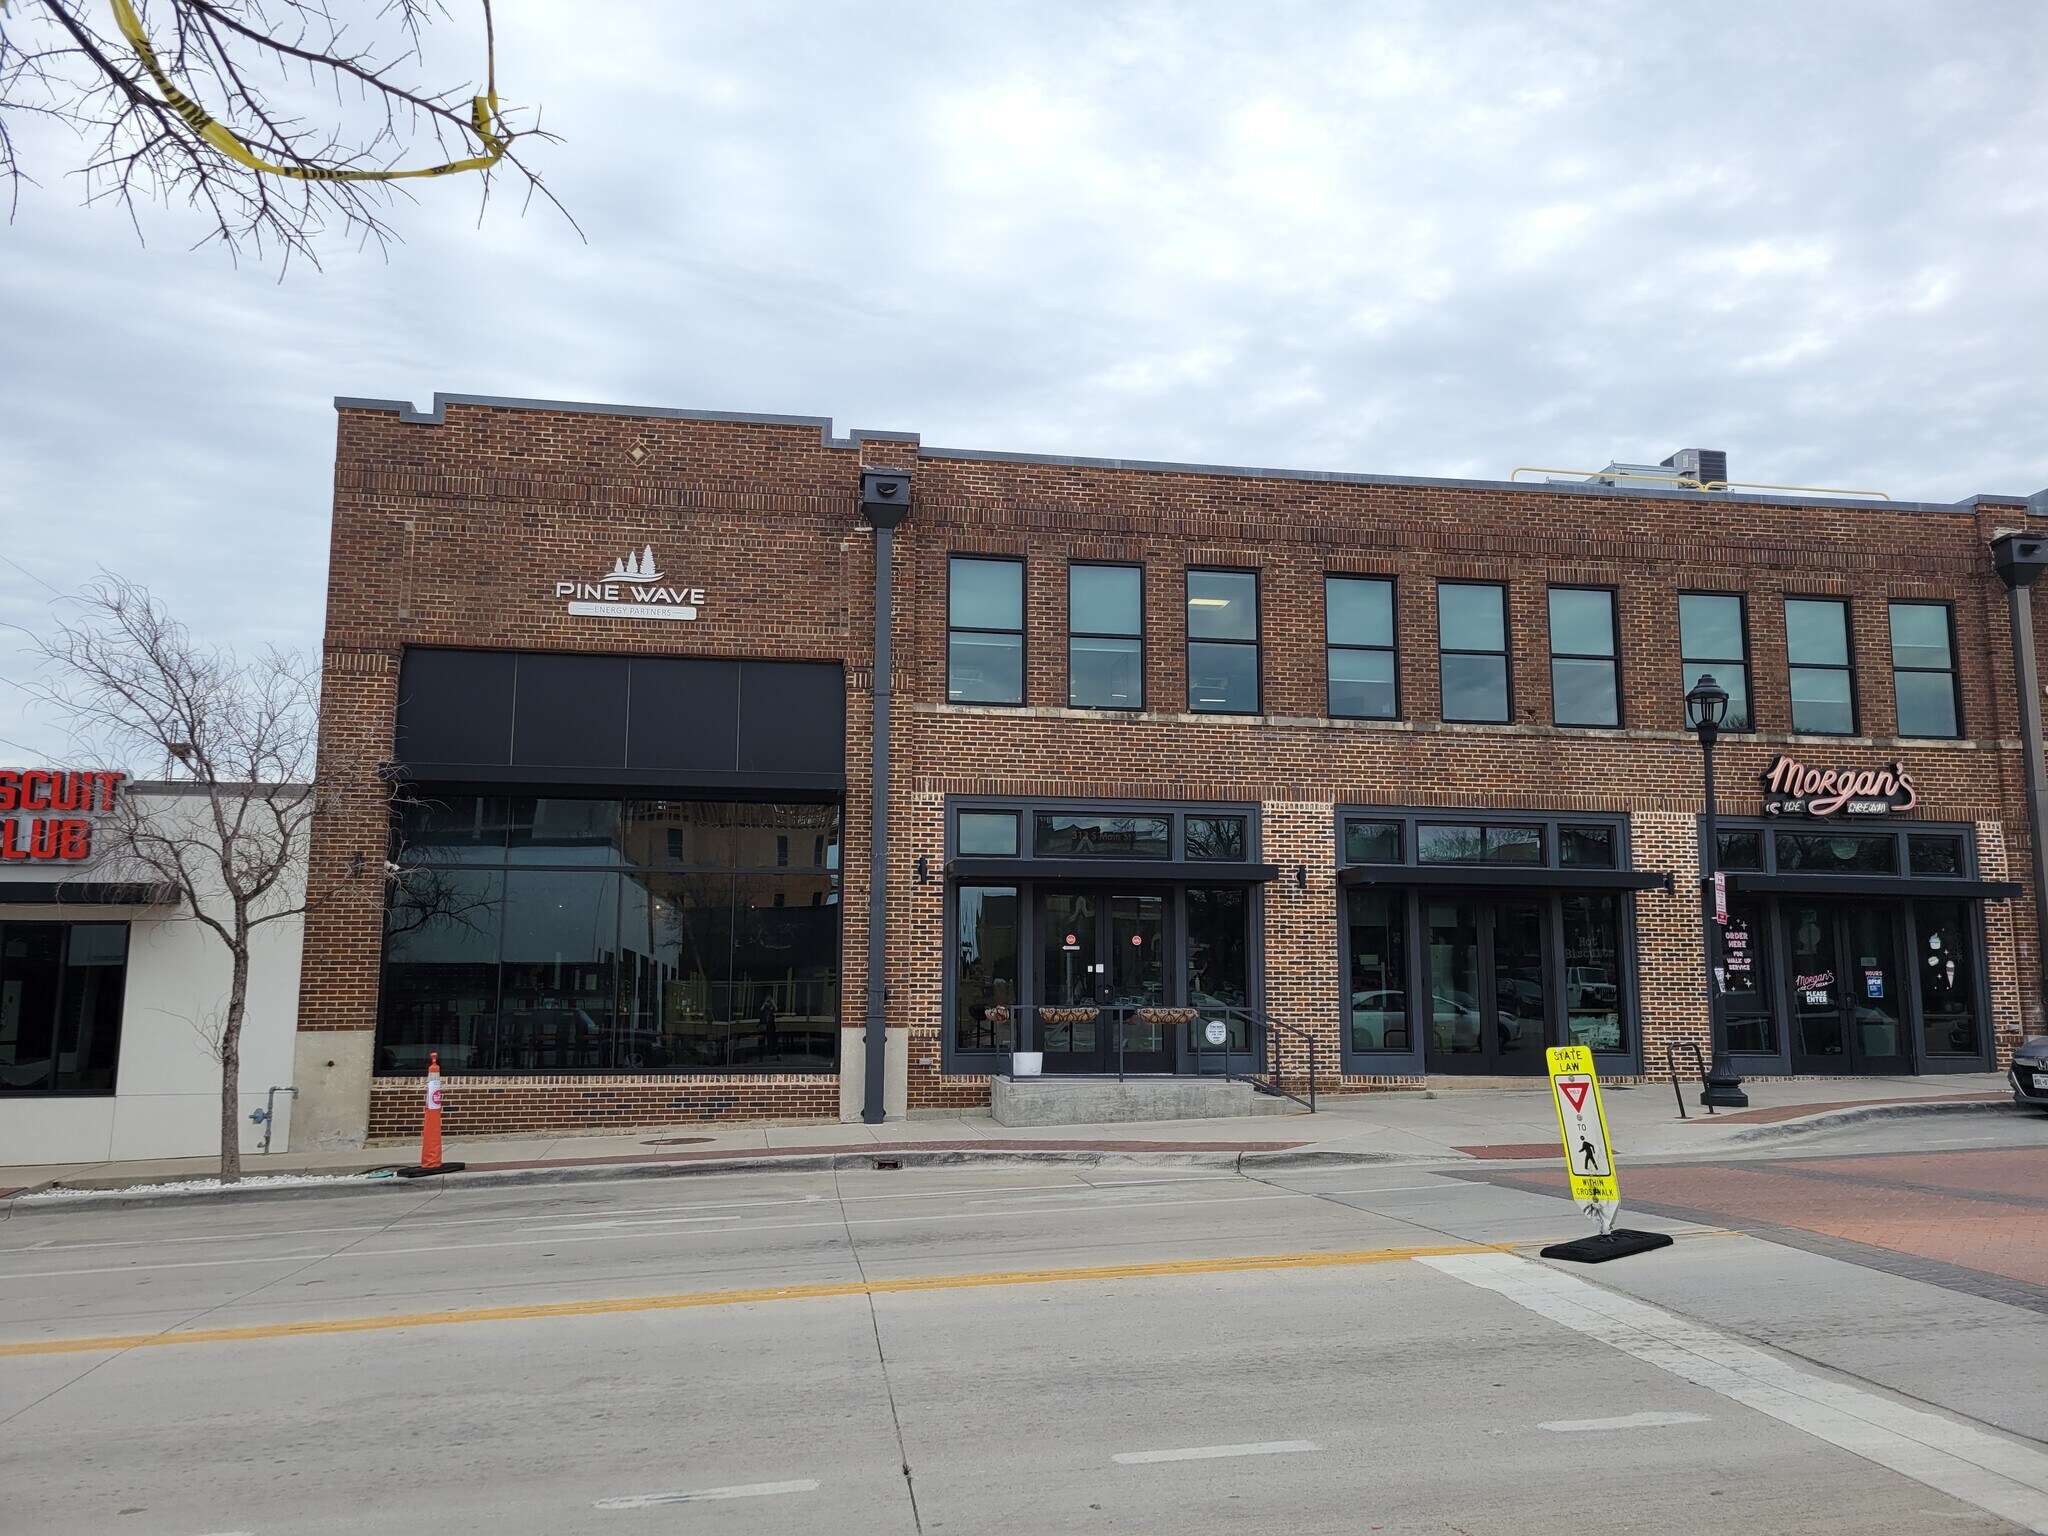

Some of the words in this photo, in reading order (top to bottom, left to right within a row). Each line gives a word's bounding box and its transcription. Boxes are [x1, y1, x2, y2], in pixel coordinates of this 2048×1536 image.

[556, 582, 620, 600] PINE
[630, 586, 705, 605] WAVE
[594, 606, 627, 614] ENERGY
[630, 607, 672, 616] PARTNERS
[1767, 755, 1917, 815] Morgan's
[0, 770, 124, 811] SCUIT
[1091, 831, 1097, 840] S
[1099, 832, 1121, 841] Main
[1123, 832, 1131, 841] St
[1579, 936, 1598, 946] Hot
[1728, 940, 1747, 948] HERE
[1565, 947, 1615, 959] Biscuits
[1553, 1050, 1583, 1061] STATE
[1559, 1062, 1580, 1072] LAW
[1576, 1123, 1587, 1132] TO
[1582, 1178, 1604, 1187] WITHIN
